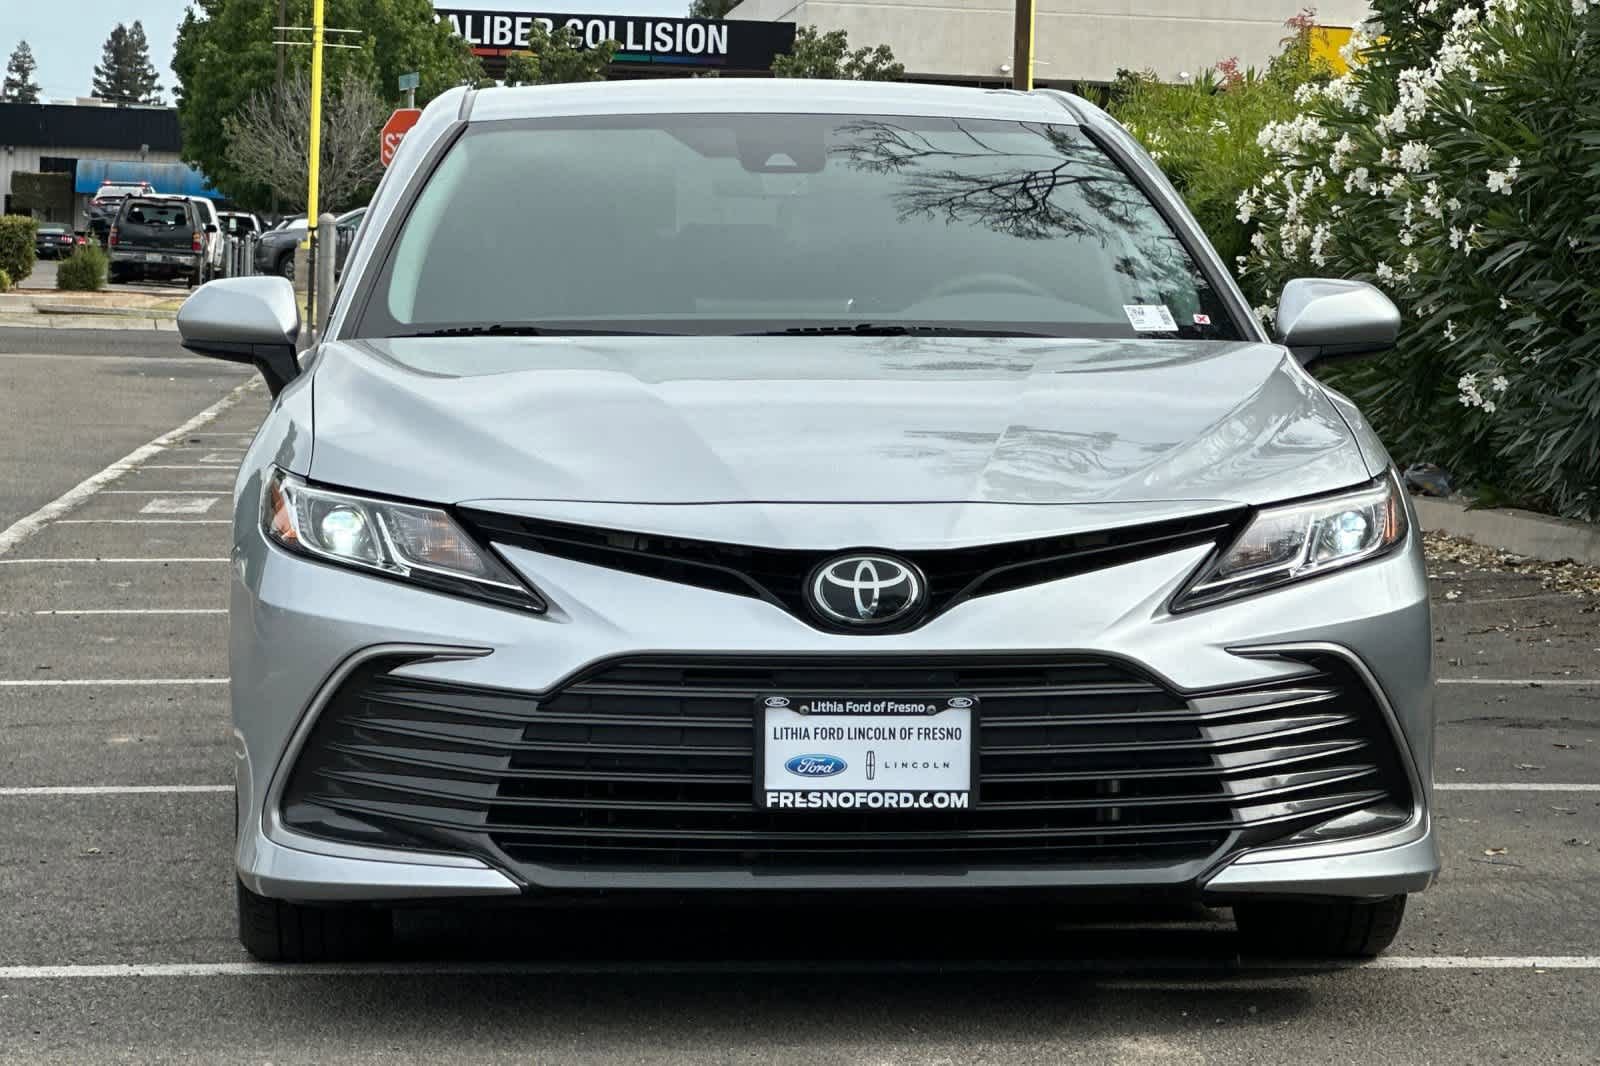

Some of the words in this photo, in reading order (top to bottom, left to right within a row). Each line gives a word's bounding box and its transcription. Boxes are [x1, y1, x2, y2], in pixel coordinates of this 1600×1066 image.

[564, 18, 728, 54] COLLISION
[811, 701, 844, 713] Lithia
[845, 701, 872, 713] Ford
[873, 701, 887, 713] of
[887, 701, 926, 713] Fresno
[773, 727, 811, 741] LITHIA
[813, 727, 844, 741] FORD
[847, 727, 896, 741] LINCOLN
[899, 727, 914, 741] OF
[917, 727, 962, 741] FRESNO
[797, 757, 835, 773] Ford
[884, 761, 950, 769] LINCOLN
[766, 791, 969, 809] FRESNOFORD.COM
